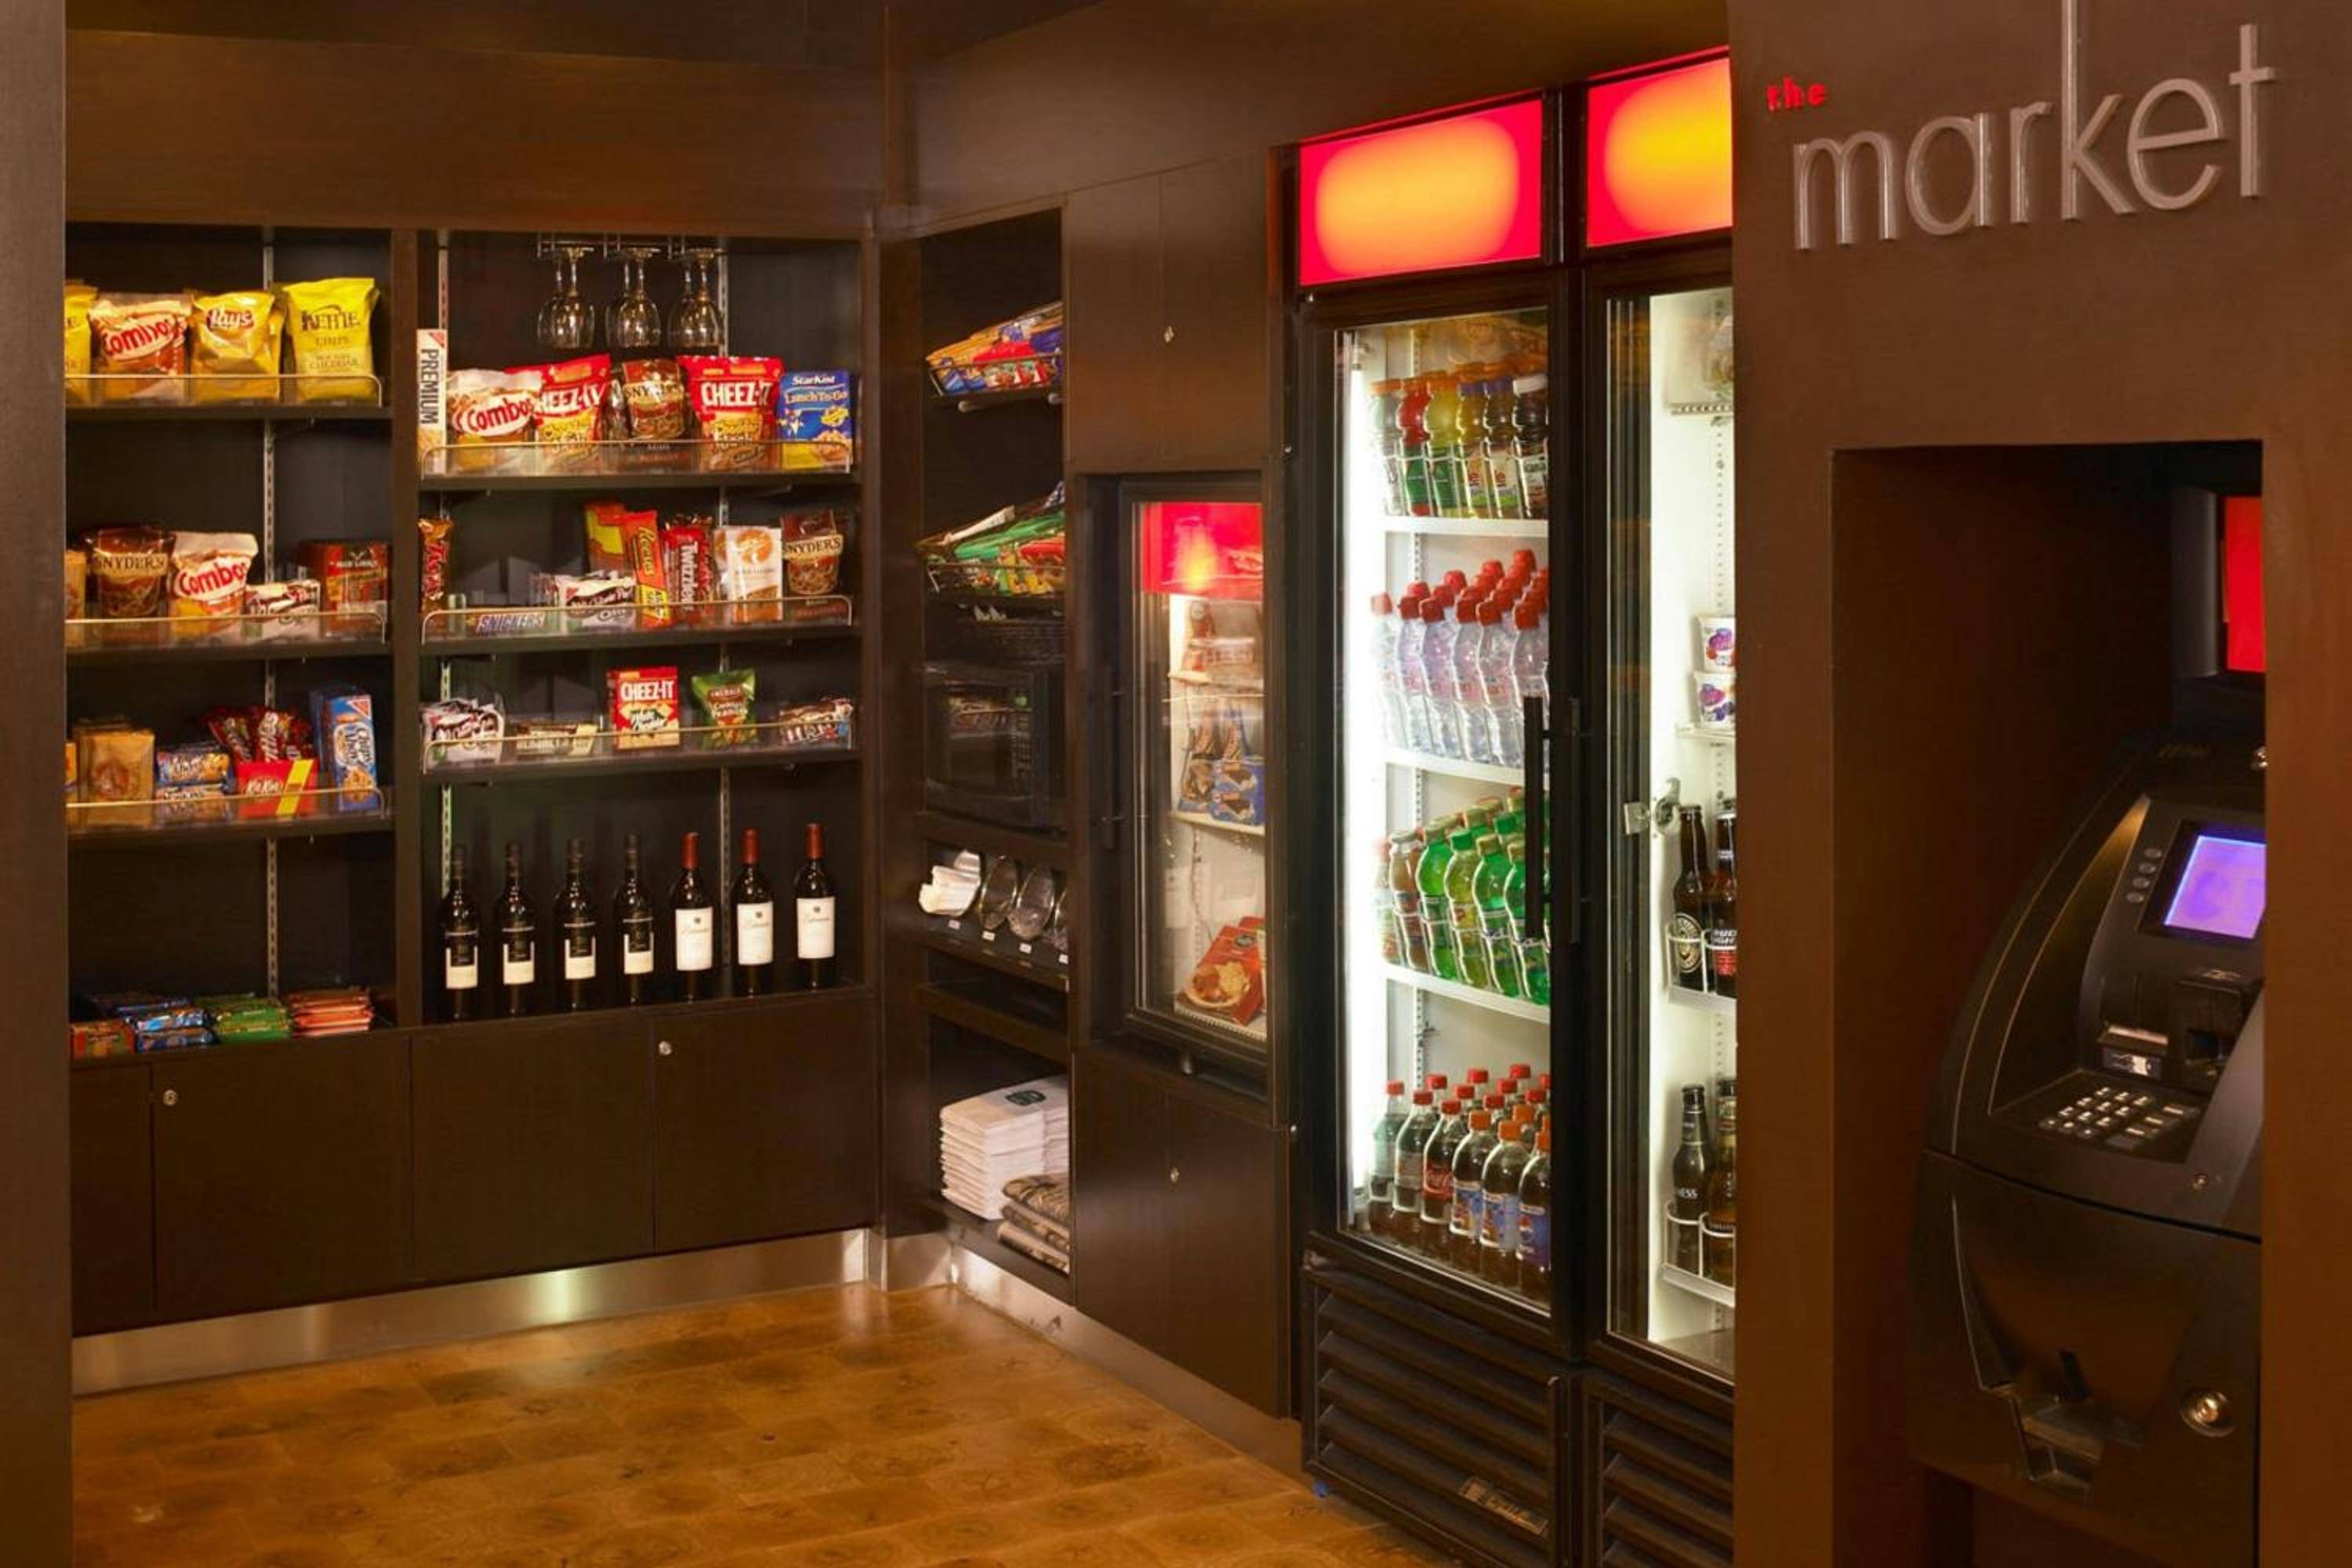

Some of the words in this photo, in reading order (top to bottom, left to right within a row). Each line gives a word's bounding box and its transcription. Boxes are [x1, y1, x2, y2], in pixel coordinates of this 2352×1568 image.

[1766, 77, 1827, 111] the
[1793, 0, 2274, 250] market
[420, 349, 439, 424] PREMIUM
[700, 381, 772, 407] CHEEZ-IT
[620, 680, 674, 702] CHEEZ-IT
